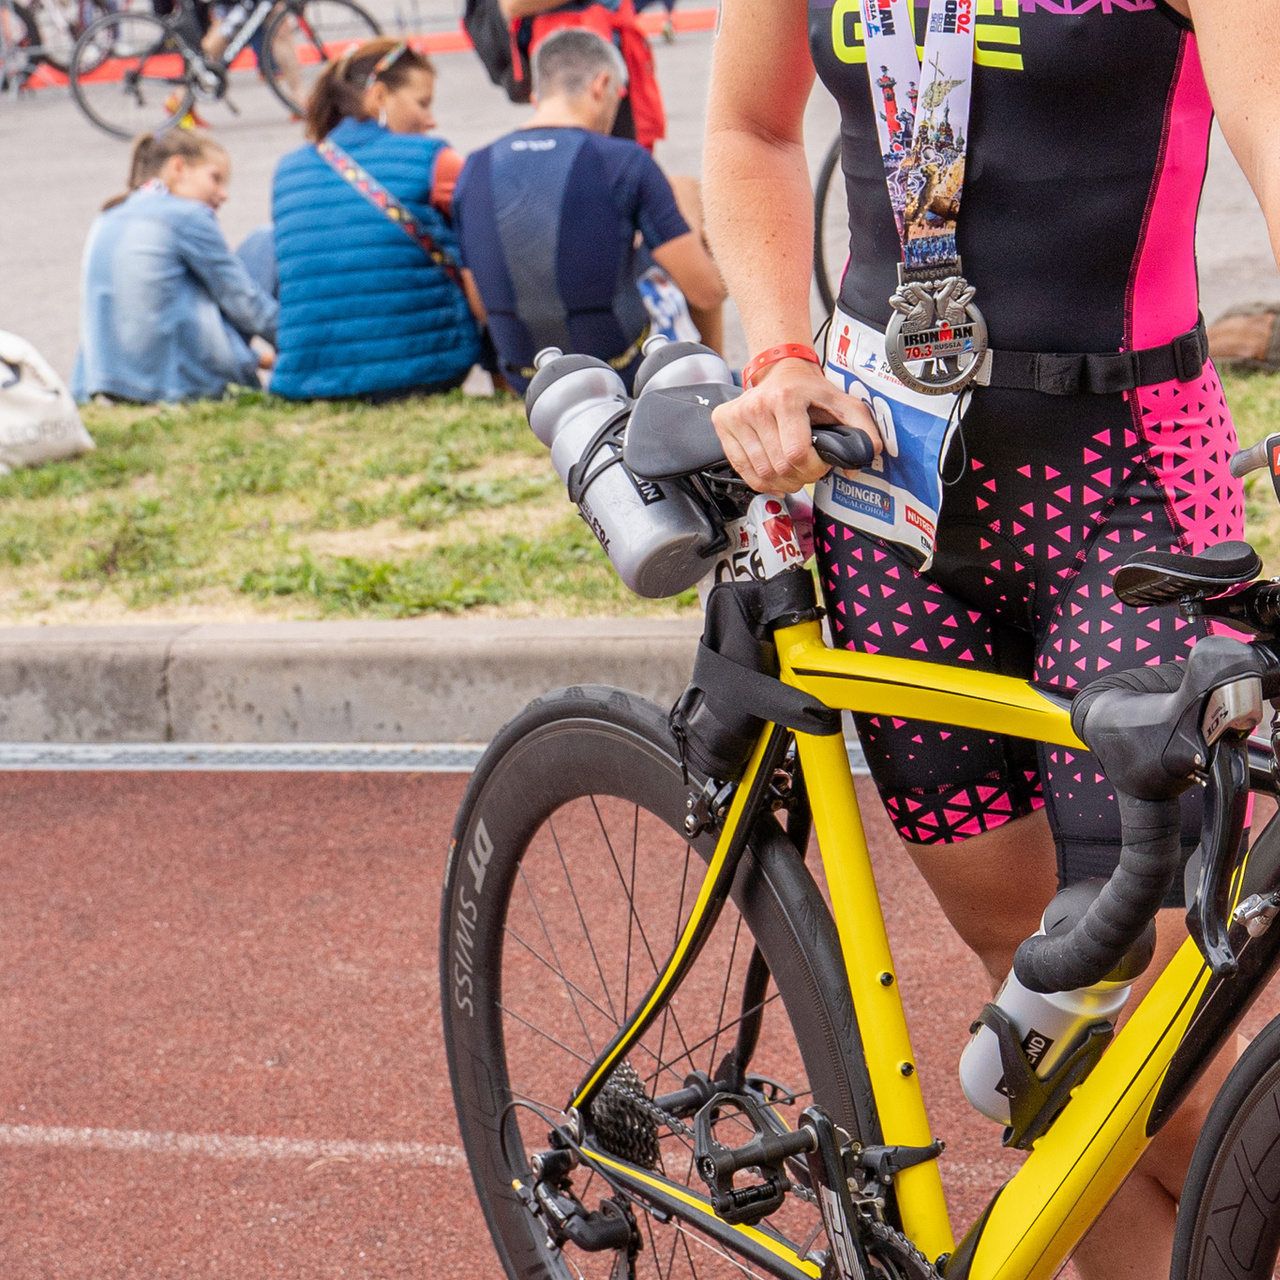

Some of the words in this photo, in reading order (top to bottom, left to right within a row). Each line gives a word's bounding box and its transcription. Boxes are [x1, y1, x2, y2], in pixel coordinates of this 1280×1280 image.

[904, 267, 958, 281] FINISHER
[903, 322, 974, 347] IRONMAN
[905, 345, 933, 360] 70.3
[934, 342, 962, 352] RUSSIA
[835, 478, 882, 508] ERDINGER
[467, 818, 494, 895] DT
[454, 886, 477, 1017] SWISS
